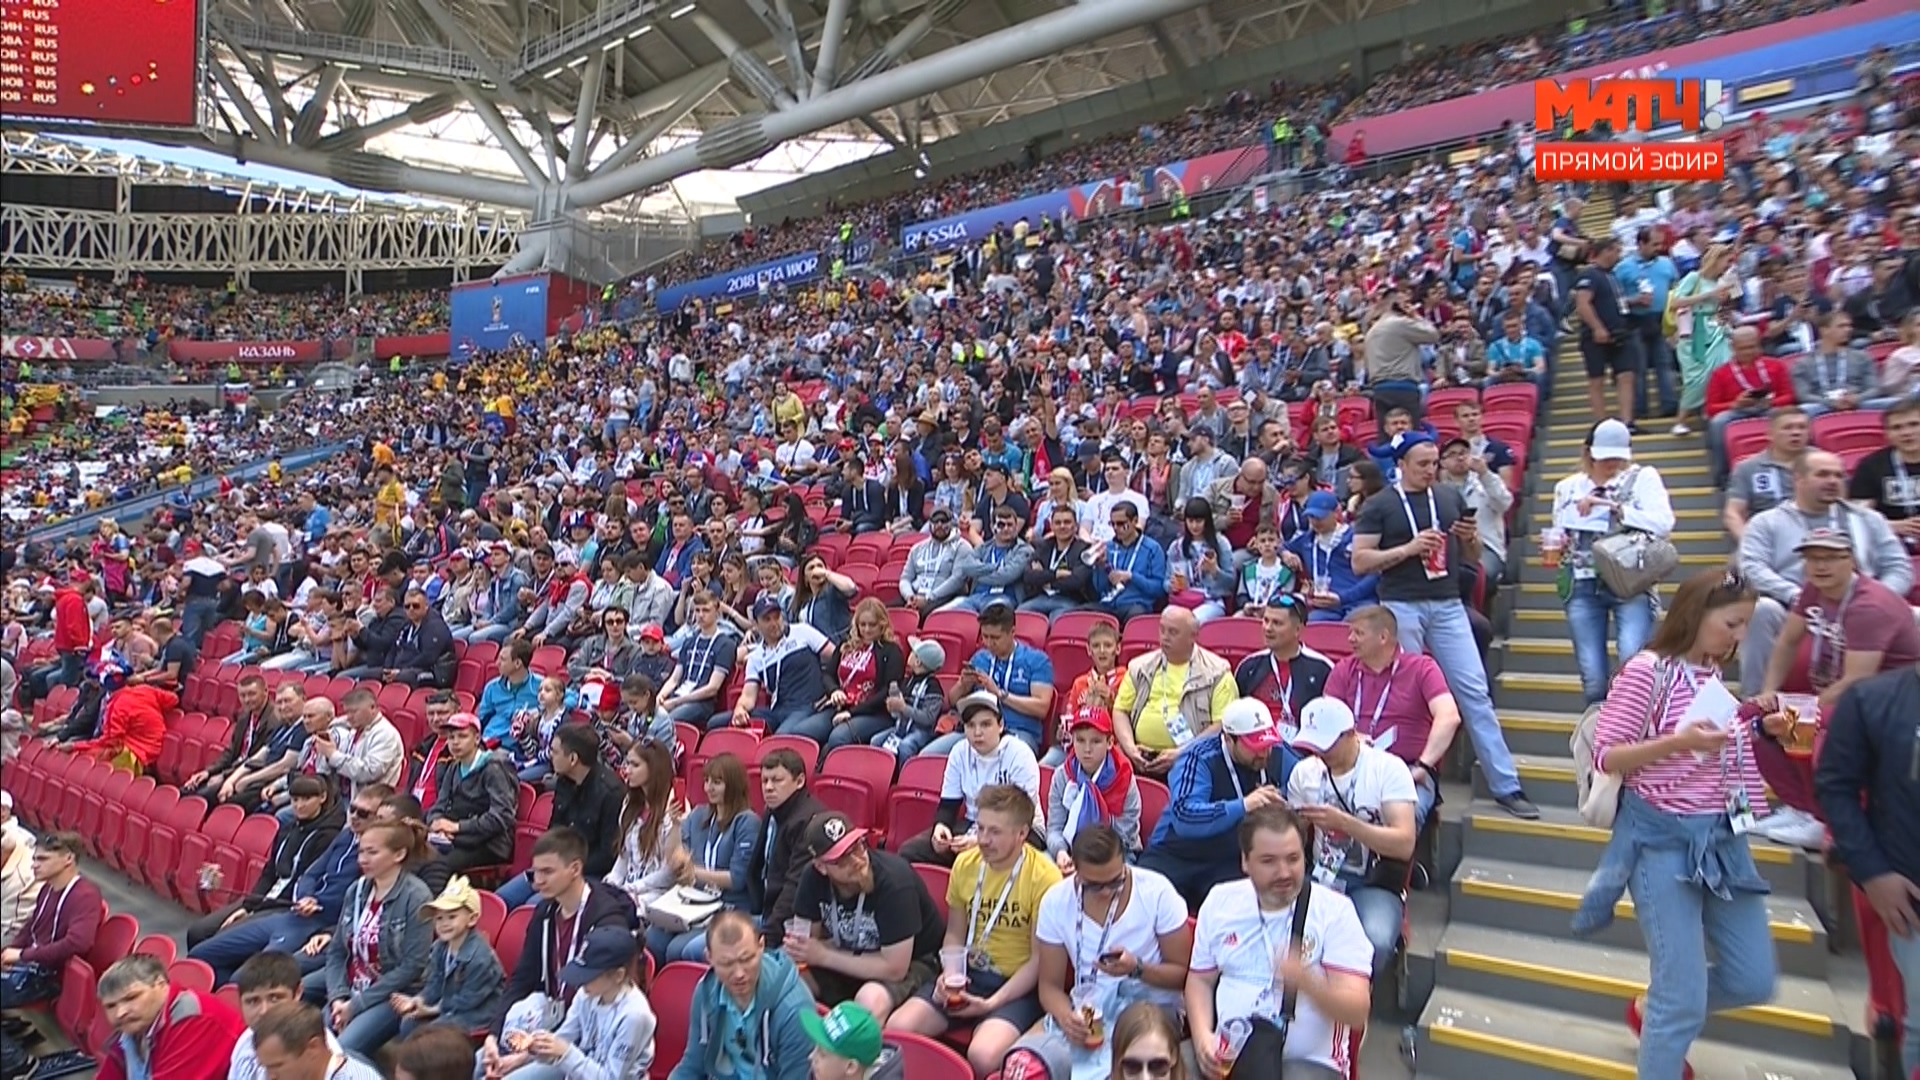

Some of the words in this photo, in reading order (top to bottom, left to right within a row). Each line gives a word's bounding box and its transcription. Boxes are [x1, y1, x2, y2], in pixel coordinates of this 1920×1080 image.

[23, 9, 50, 21] RUS
[34, 23, 59, 35] RUS
[34, 37, 58, 49] RUS
[31, 51, 58, 63] RUS
[34, 65, 57, 77] RUS
[36, 79, 57, 91] RUS
[33, 93, 57, 105] RUS
[727, 273, 755, 293] 2018
[757, 266, 785, 286] FFA
[238, 345, 297, 359] КАЗАНЬ
